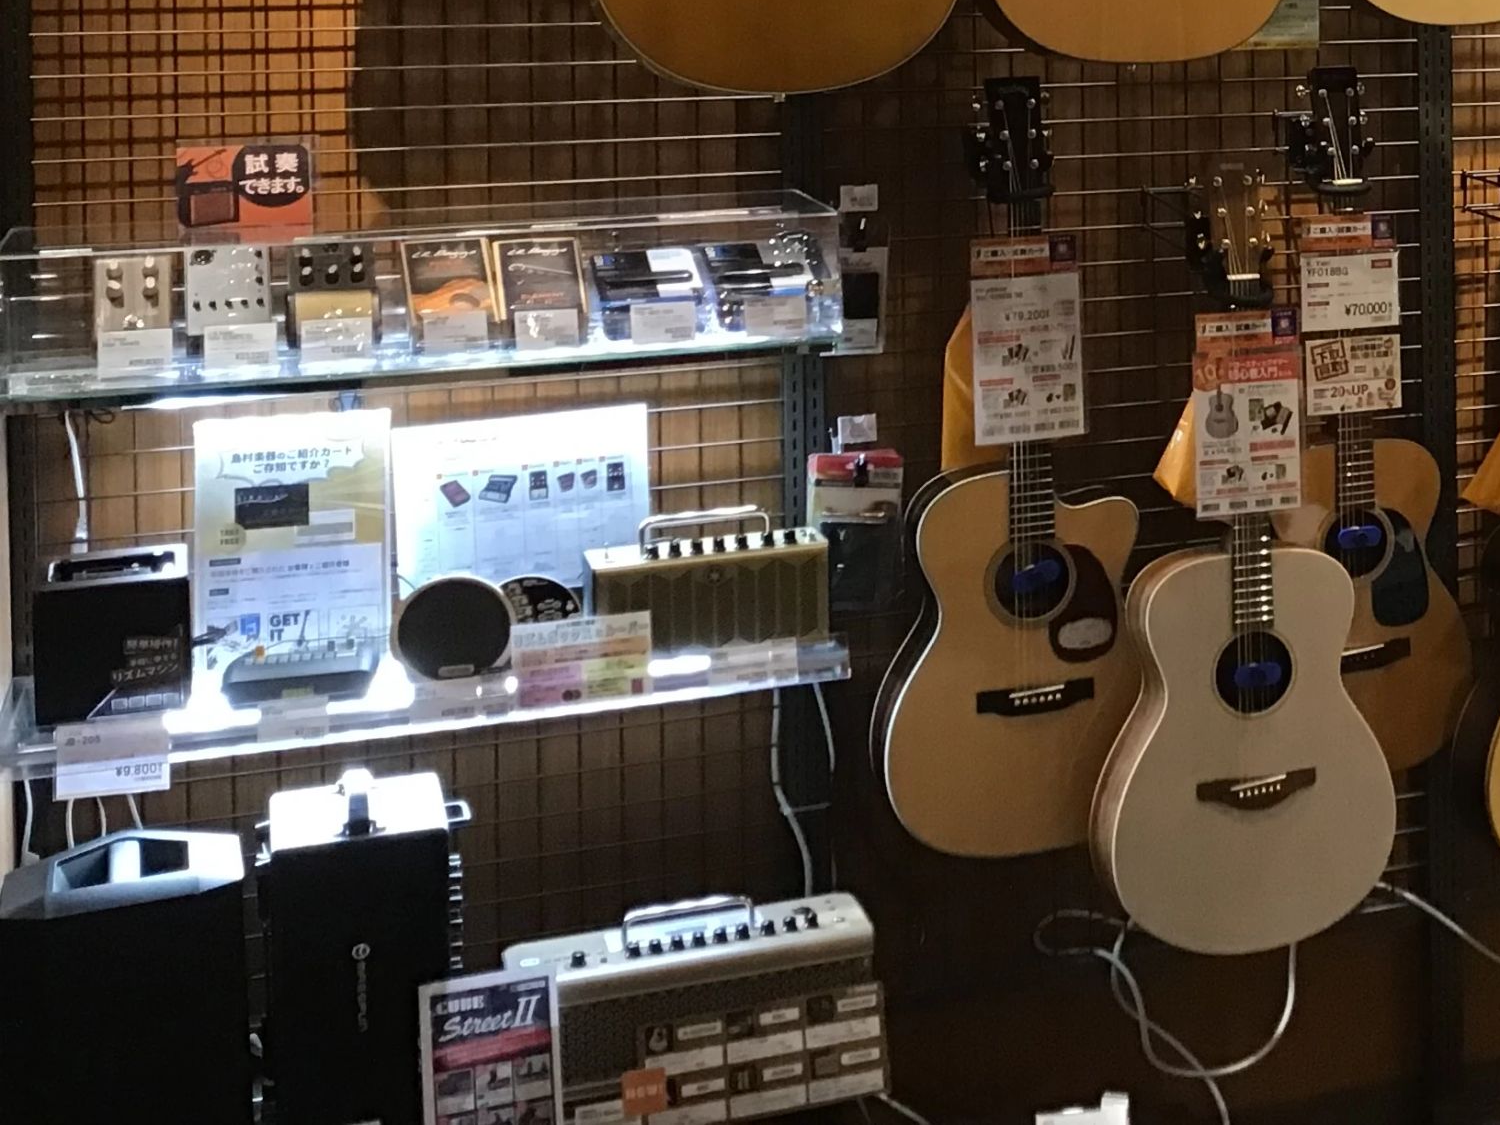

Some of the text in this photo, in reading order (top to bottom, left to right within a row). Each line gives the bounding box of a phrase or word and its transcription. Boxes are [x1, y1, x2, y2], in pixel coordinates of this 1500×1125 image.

[244, 152, 299, 174] 試奏
[238, 176, 304, 195] できます。
[1345, 301, 1387, 317] ¥70,000
[269, 613, 301, 627] GET
[269, 629, 284, 642] IT
